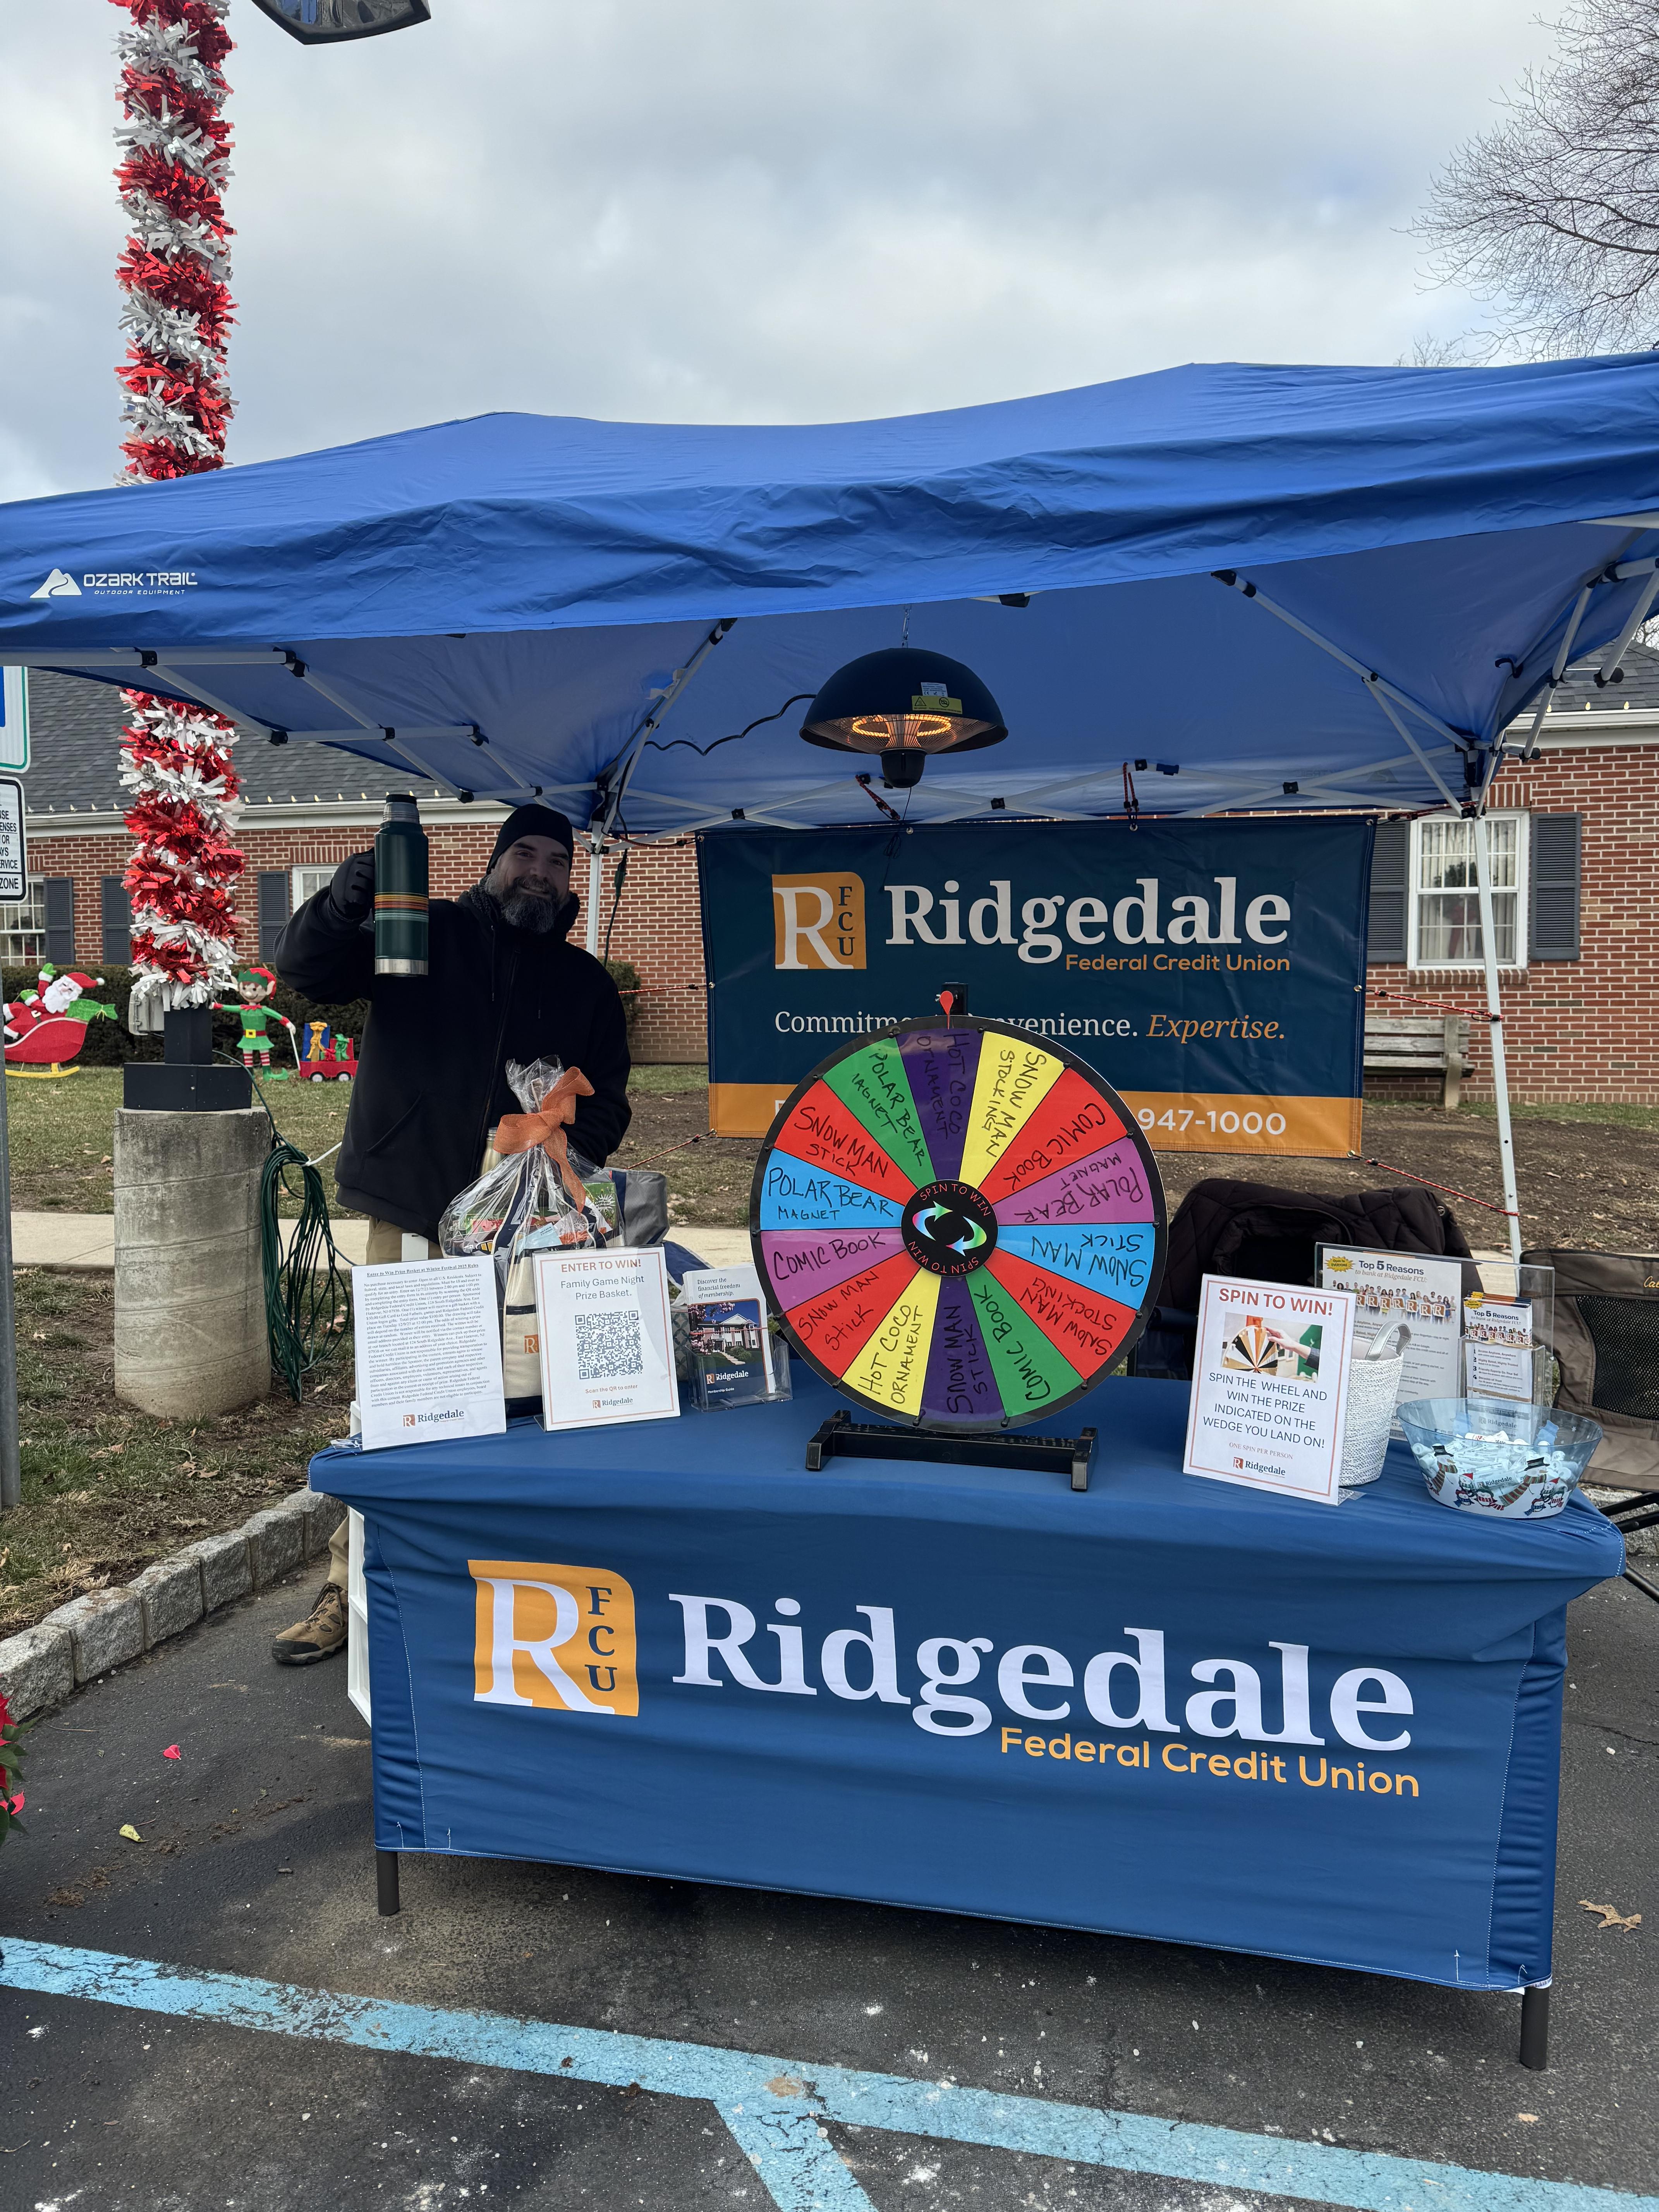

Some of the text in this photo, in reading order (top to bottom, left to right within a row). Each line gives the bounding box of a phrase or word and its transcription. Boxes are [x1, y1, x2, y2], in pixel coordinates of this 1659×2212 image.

[84, 572, 198, 587] OZARK TRAIL
[0, 822, 17, 832] ENSES
[773, 887, 854, 969] R
[884, 877, 1290, 963] Ridgedale
[1066, 954, 1290, 971] Federal Credit Union
[1146, 1014, 1285, 1044] Expertise.
[943, 1033, 970, 1134] HOT COCO
[986, 1052, 1047, 1157] SNOW MAN
[896, 1108, 925, 1166] BEAR
[1137, 1108, 1286, 1135] 947-1000
[1003, 1103, 1106, 1191] COMIC BOOK
[1061, 1153, 1122, 1190] MAGNET
[769, 1167, 893, 1218] POLAR BEAR
[920, 1183, 991, 1216] SPIN TO WIN
[1014, 1167, 1143, 1223] POLAR BEAR
[778, 1205, 840, 1220] MAGNET
[774, 1232, 886, 1280] COMIC BOOK
[908, 1241, 979, 1273] SPIN TO WIN
[1081, 1234, 1144, 1252] STICK
[561, 1259, 641, 1272] ENTER TO WIN!
[1032, 1236, 1147, 1287] SNOW MAN
[1358, 1260, 1424, 1275] Top 5 Reasons
[1384, 1272, 1412, 1281] Ridgedale
[561, 1279, 590, 1288] Family
[622, 1276, 644, 1285] Night
[576, 1289, 632, 1300] Prize Basket.
[799, 1271, 879, 1340] SNOW MAN
[1032, 1277, 1117, 1330] STOCKING
[1219, 1288, 1333, 1316] SPIN TO WIN!
[944, 1306, 963, 1348] MAN
[1020, 1288, 1112, 1355] SNOW MAN
[858, 1305, 911, 1395] HOT COCO
[891, 1305, 923, 1404] ORNAMENT
[974, 1285, 1051, 1400] COMIC BOOK
[716, 1370, 749, 1381] Ridgedale
[964, 1324, 988, 1395] STICK
[602, 1397, 633, 1406] Ridgedale
[1209, 1372, 1327, 1401] SPIN THE WHEEL AND
[1227, 1390, 1305, 1413] WIN THE PRIZE
[418, 1409, 464, 1422] Ridgedale
[1215, 1403, 1316, 1431] INDICATED ON THE
[1487, 1419, 1517, 1429] Ridgedale
[1203, 1416, 1325, 1448] WEDGE YOU LAND ON!
[1245, 1460, 1286, 1475] Ridgedale
[1270, 1450, 1293, 1459] PERSON
[1485, 1477, 1513, 1486] Ridgedale
[472, 1576, 618, 1716] R
[668, 1593, 1414, 1751] Ridgedale
[1001, 1727, 1419, 1798] Federal Credit Union
